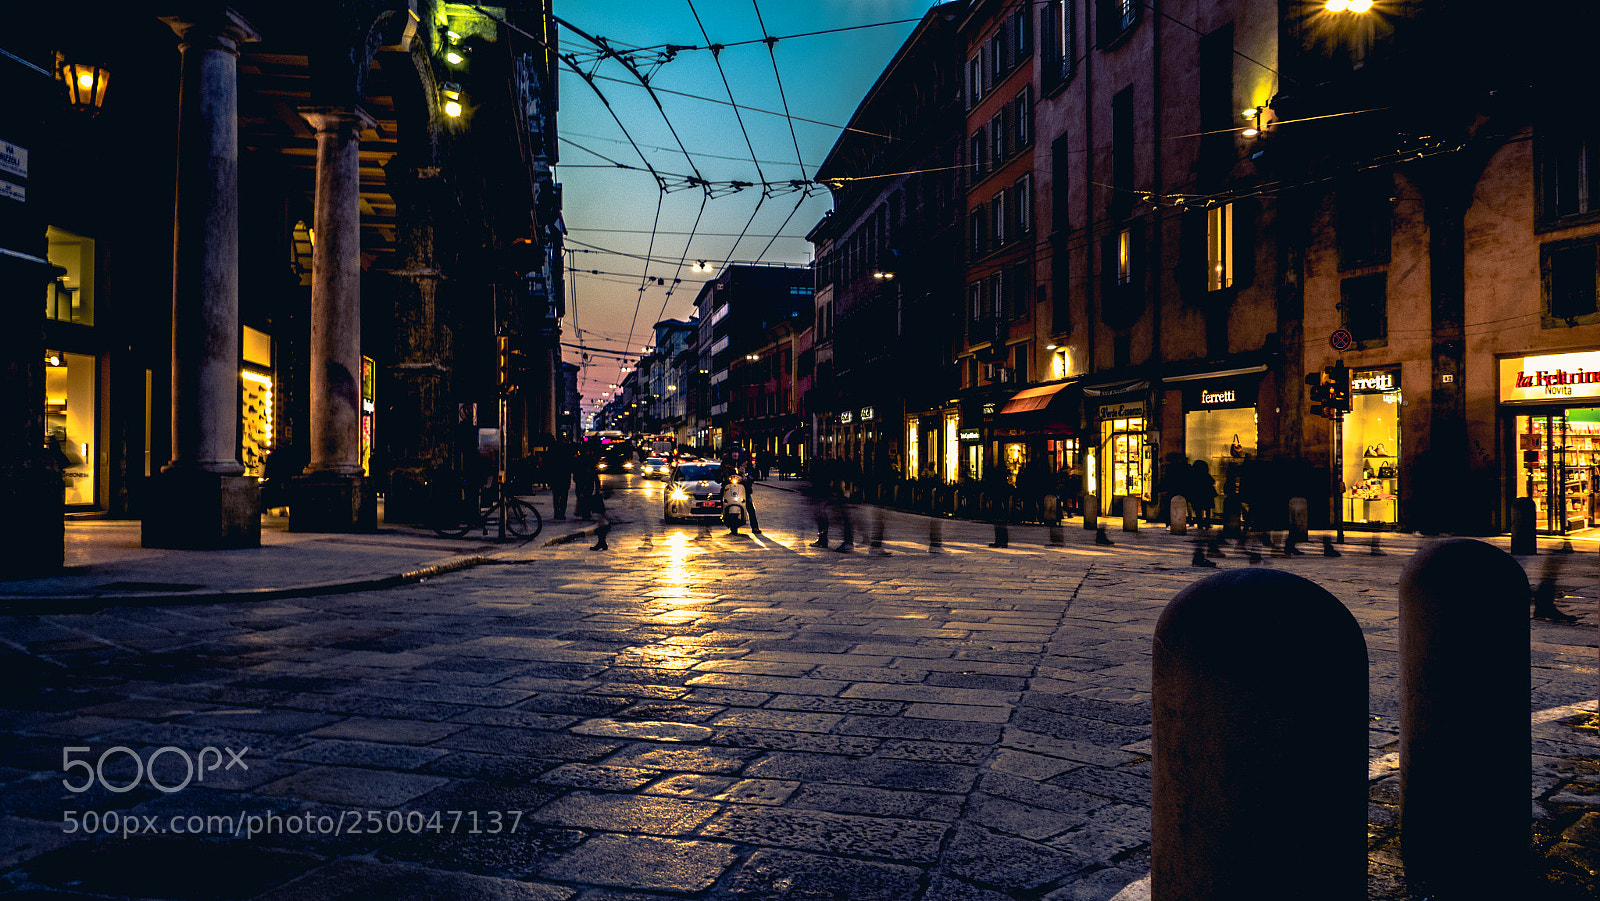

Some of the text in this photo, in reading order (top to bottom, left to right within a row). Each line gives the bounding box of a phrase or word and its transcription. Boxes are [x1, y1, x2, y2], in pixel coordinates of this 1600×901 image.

[1351, 374, 1393, 390] erretti
[1515, 371, 1533, 388] la
[1201, 389, 1236, 404] ferretti
